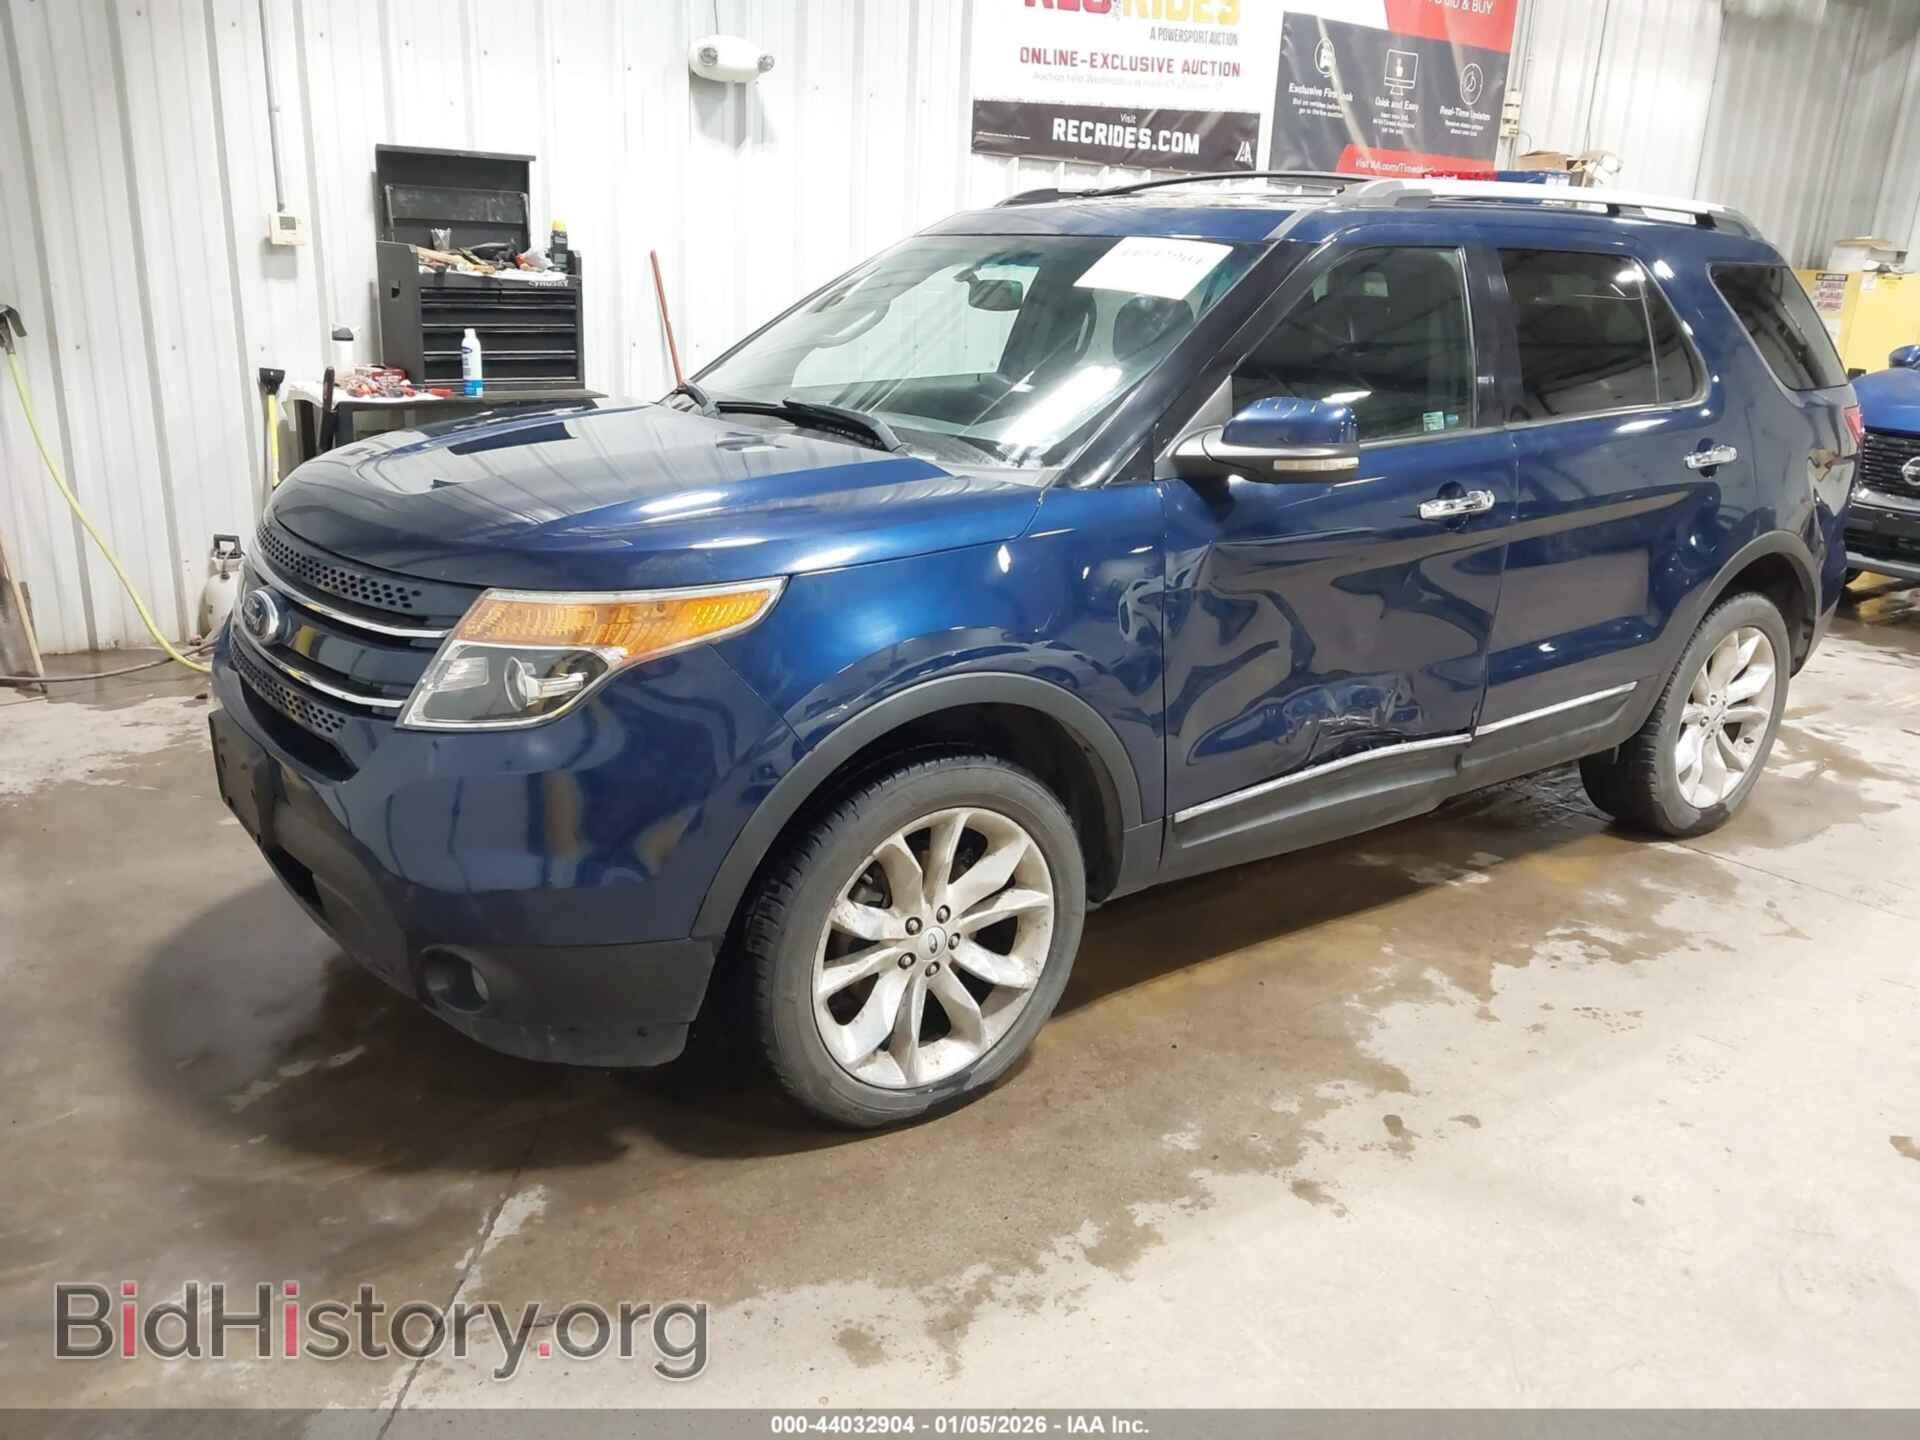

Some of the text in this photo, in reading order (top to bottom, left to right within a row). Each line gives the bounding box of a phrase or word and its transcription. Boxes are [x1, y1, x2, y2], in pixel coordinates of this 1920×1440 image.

[1472, 0, 1493, 14] BUY
[1158, 27, 1208, 45] POWERSPORT
[1209, 31, 1238, 46] AUCTION
[1019, 46, 1241, 77] ONLINE-EXCLUSIVE AUCTION
[1288, 82, 1322, 97] Exclusive
[1404, 100, 1419, 112] Easy
[1120, 112, 1136, 124] Visit
[1052, 117, 1200, 154] RECRIDES.COM
